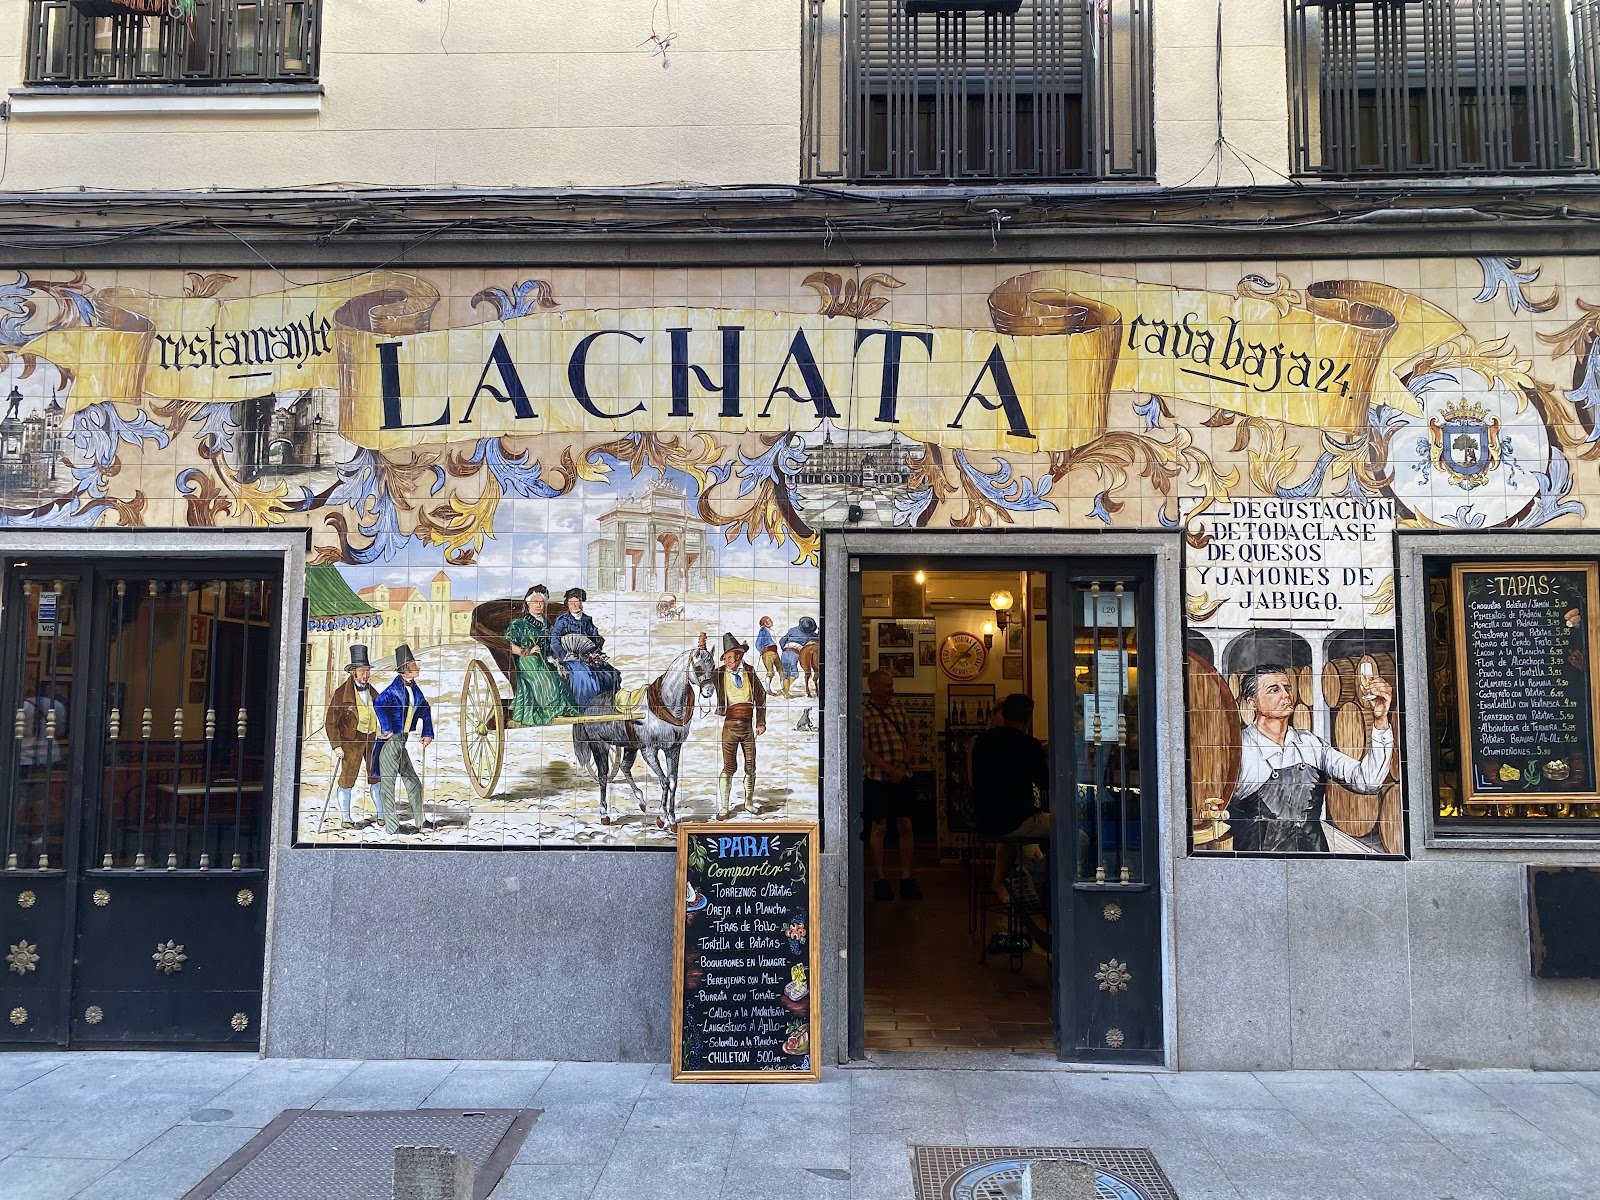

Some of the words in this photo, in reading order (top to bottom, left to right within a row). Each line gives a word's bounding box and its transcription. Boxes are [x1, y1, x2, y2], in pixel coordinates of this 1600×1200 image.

[155, 311, 332, 370] restaurante
[1302, 523, 1376, 542] CLASE
[1207, 544, 1235, 561] DE
[1238, 544, 1322, 563] QUESOS
[1196, 567, 1213, 585] Y
[1216, 567, 1330, 586] JAMONES
[1343, 567, 1374, 586] DE
[1494, 575, 1550, 596] TAPAS
[1102, 606, 1115, 614] L20
[1239, 591, 1343, 610] JABUGO.
[718, 836, 770, 858] PARA
